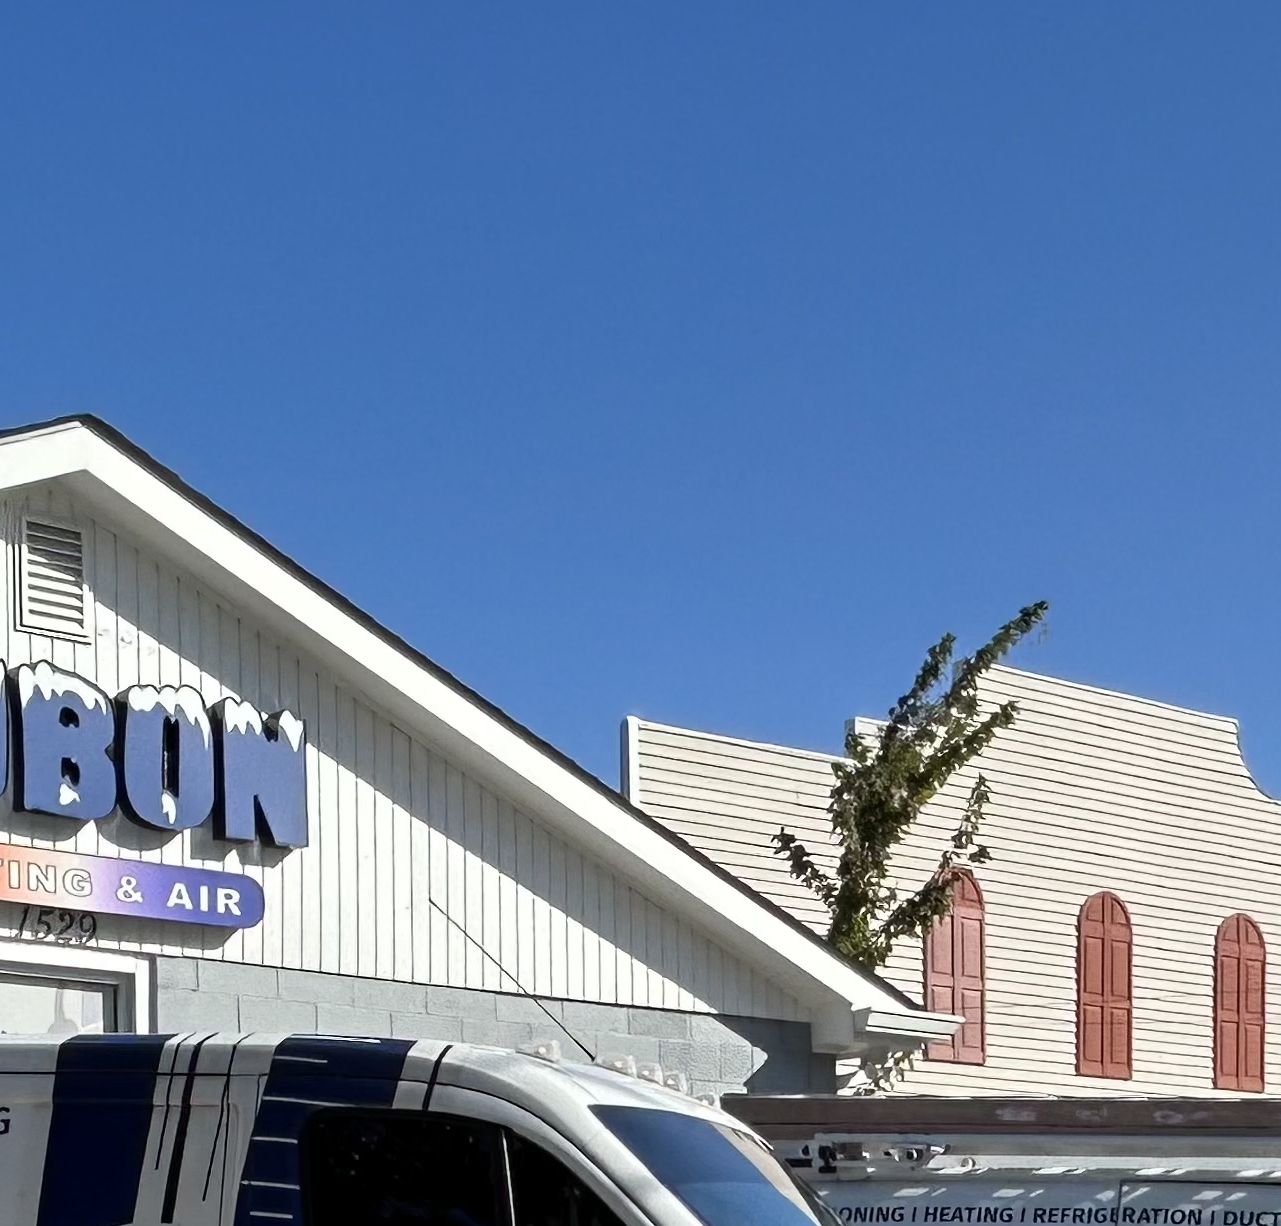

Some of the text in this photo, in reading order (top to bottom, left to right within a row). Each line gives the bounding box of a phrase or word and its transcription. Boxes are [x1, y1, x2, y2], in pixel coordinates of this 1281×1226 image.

[117, 876, 144, 904] &
[166, 881, 243, 917] AIR
[18, 906, 98, 944] 1529
[924, 1206, 1014, 1224] HEATING
[1032, 1207, 1203, 1226] REFRIGERATION
